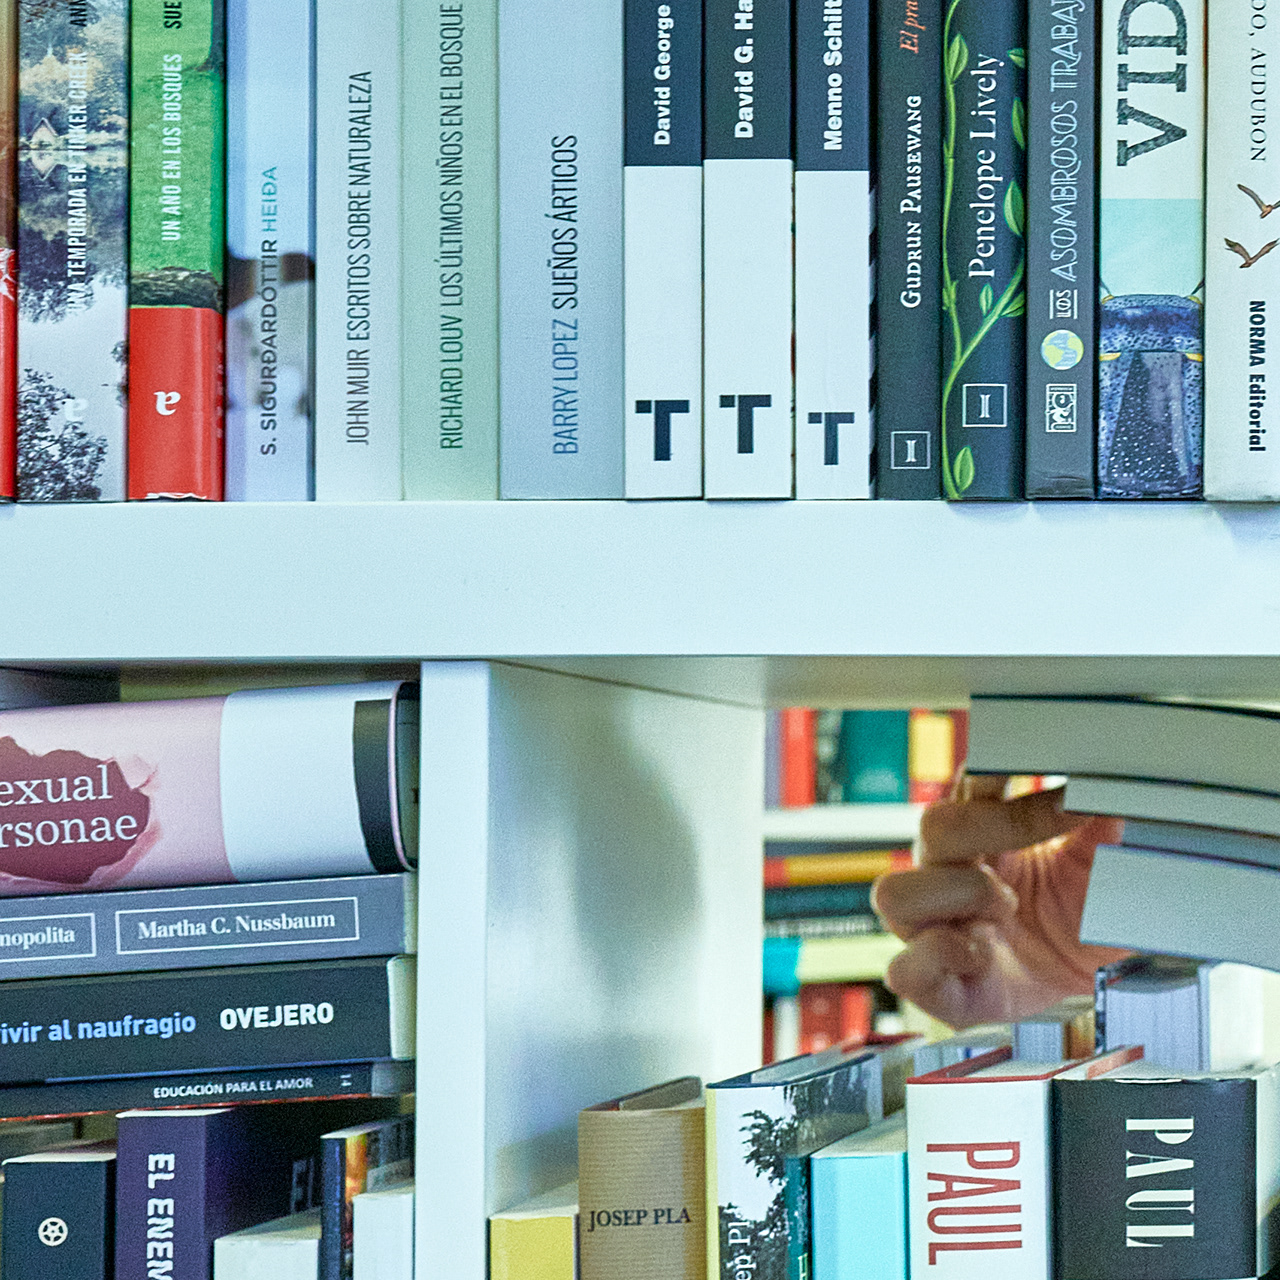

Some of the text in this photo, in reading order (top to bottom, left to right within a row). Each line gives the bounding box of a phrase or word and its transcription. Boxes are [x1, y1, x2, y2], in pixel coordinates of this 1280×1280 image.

[968, 52, 1005, 279] Penelope Lively
[346, 71, 372, 446] JOHN MUIR ESCRITOS SOBRE NATURALEZA
[543, 134, 578, 454] BARRY LOPEZ SUEÑOS ÁRTICOS
[1250, 300, 1266, 452] NORMA Editorial
[138, 912, 335, 940] Martha C. Nussbaum
[220, 1002, 334, 1031] OVEJERO
[154, 1077, 313, 1098] EDUCACIÓN PARA EL AMOR
[147, 1153, 175, 1189] EL
[588, 1208, 692, 1232] JOSEP PLA
[926, 1141, 1023, 1266] PAUL
[1125, 1118, 1194, 1248] PAUL
